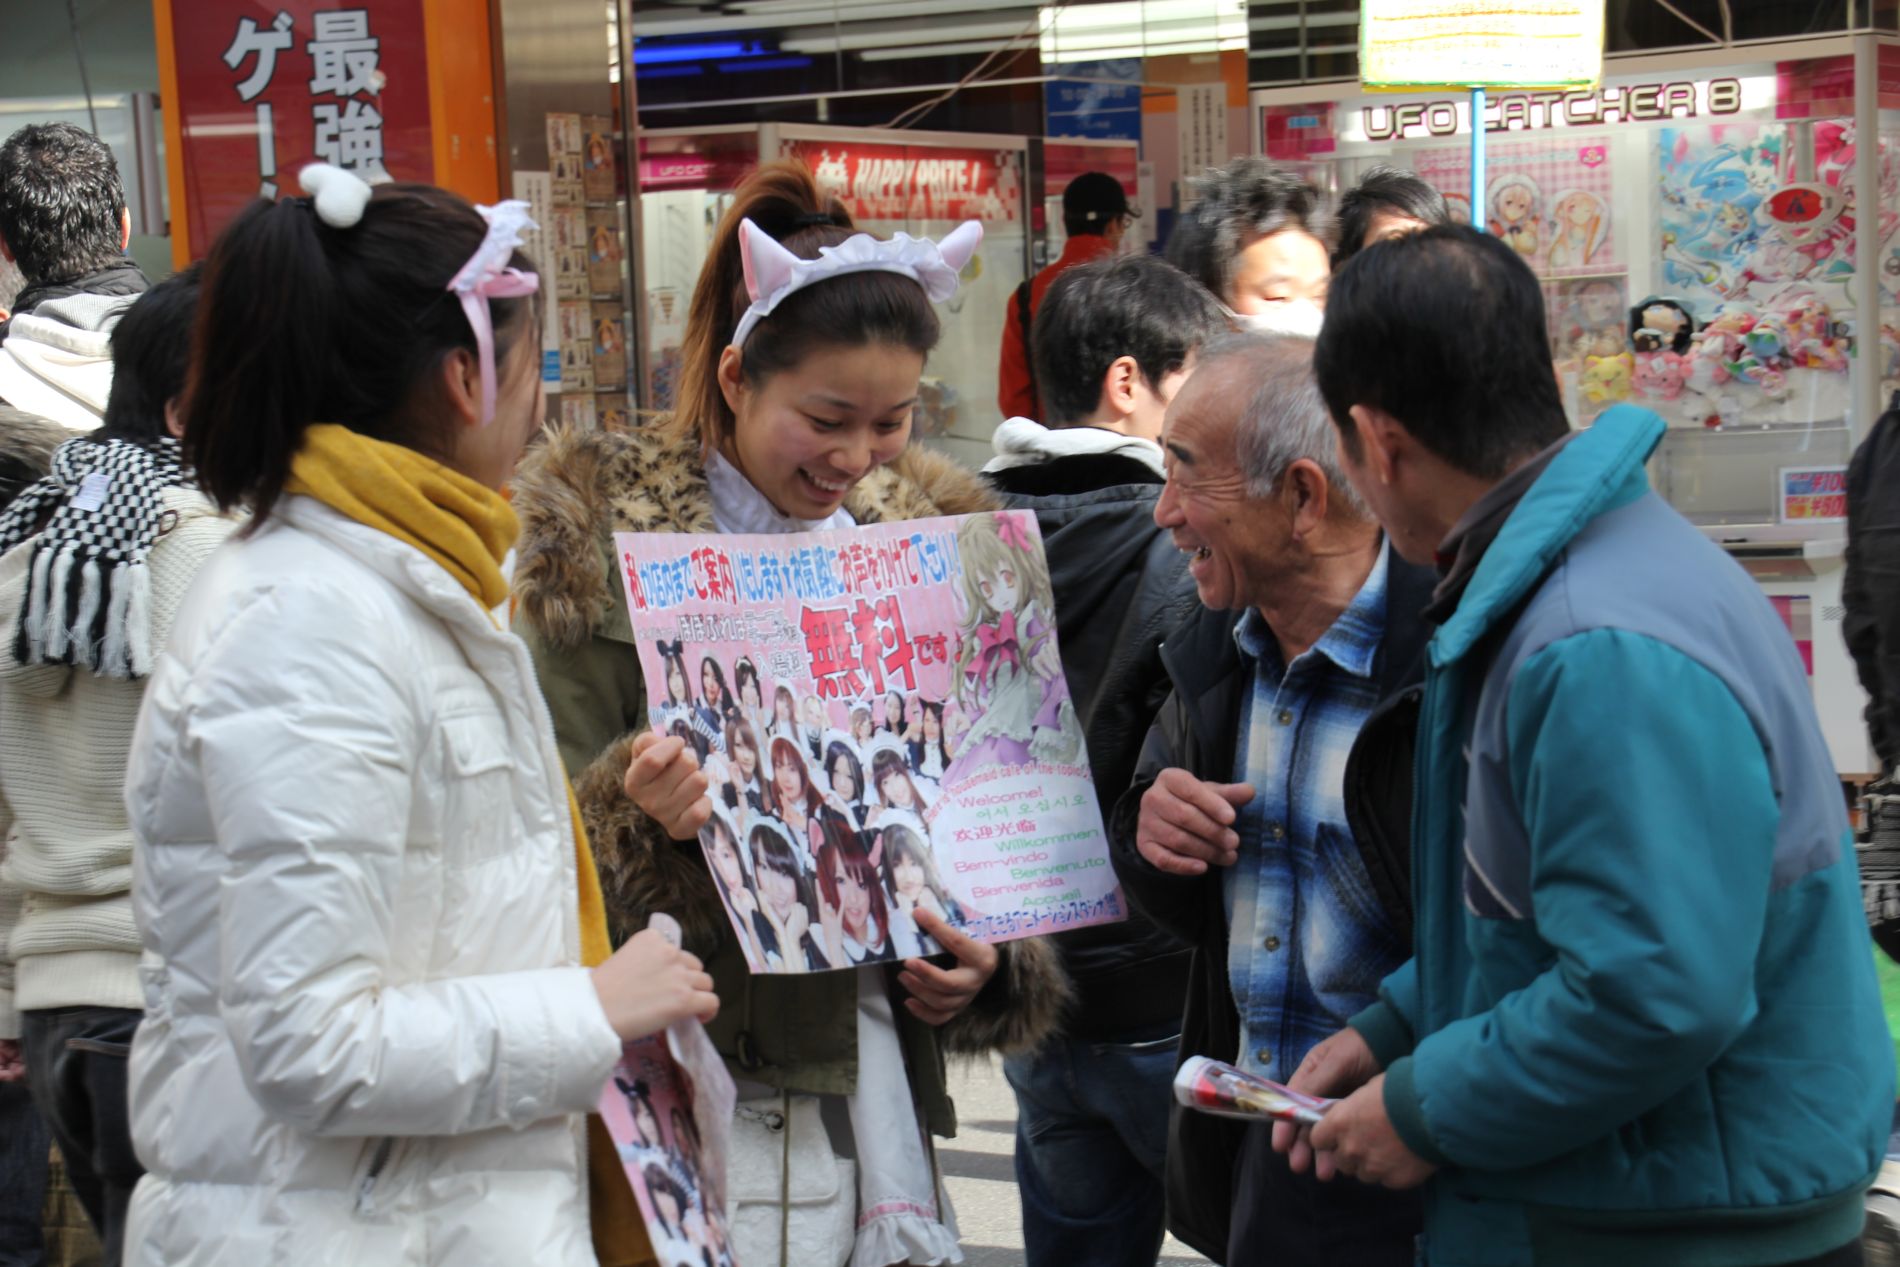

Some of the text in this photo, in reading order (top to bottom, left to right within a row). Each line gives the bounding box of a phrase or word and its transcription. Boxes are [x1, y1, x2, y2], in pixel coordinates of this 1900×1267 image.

[223, 11, 294, 200] ゲー
[306, 9, 394, 186] 最強
[1362, 101, 1457, 140] UFO
[1708, 78, 1741, 115] 8
[853, 158, 916, 198] HAPPY
[1000, 763, 1021, 777] cafe
[957, 786, 1044, 808] Welcome!
[976, 794, 1088, 820] 어서 오십시오
[994, 828, 1100, 852] Willkommen
[954, 851, 1049, 874] Bem-vindo
[1010, 857, 1107, 880] Benvenuto
[971, 875, 1065, 898] Bienvenida
[1022, 887, 1082, 906] Accueil
